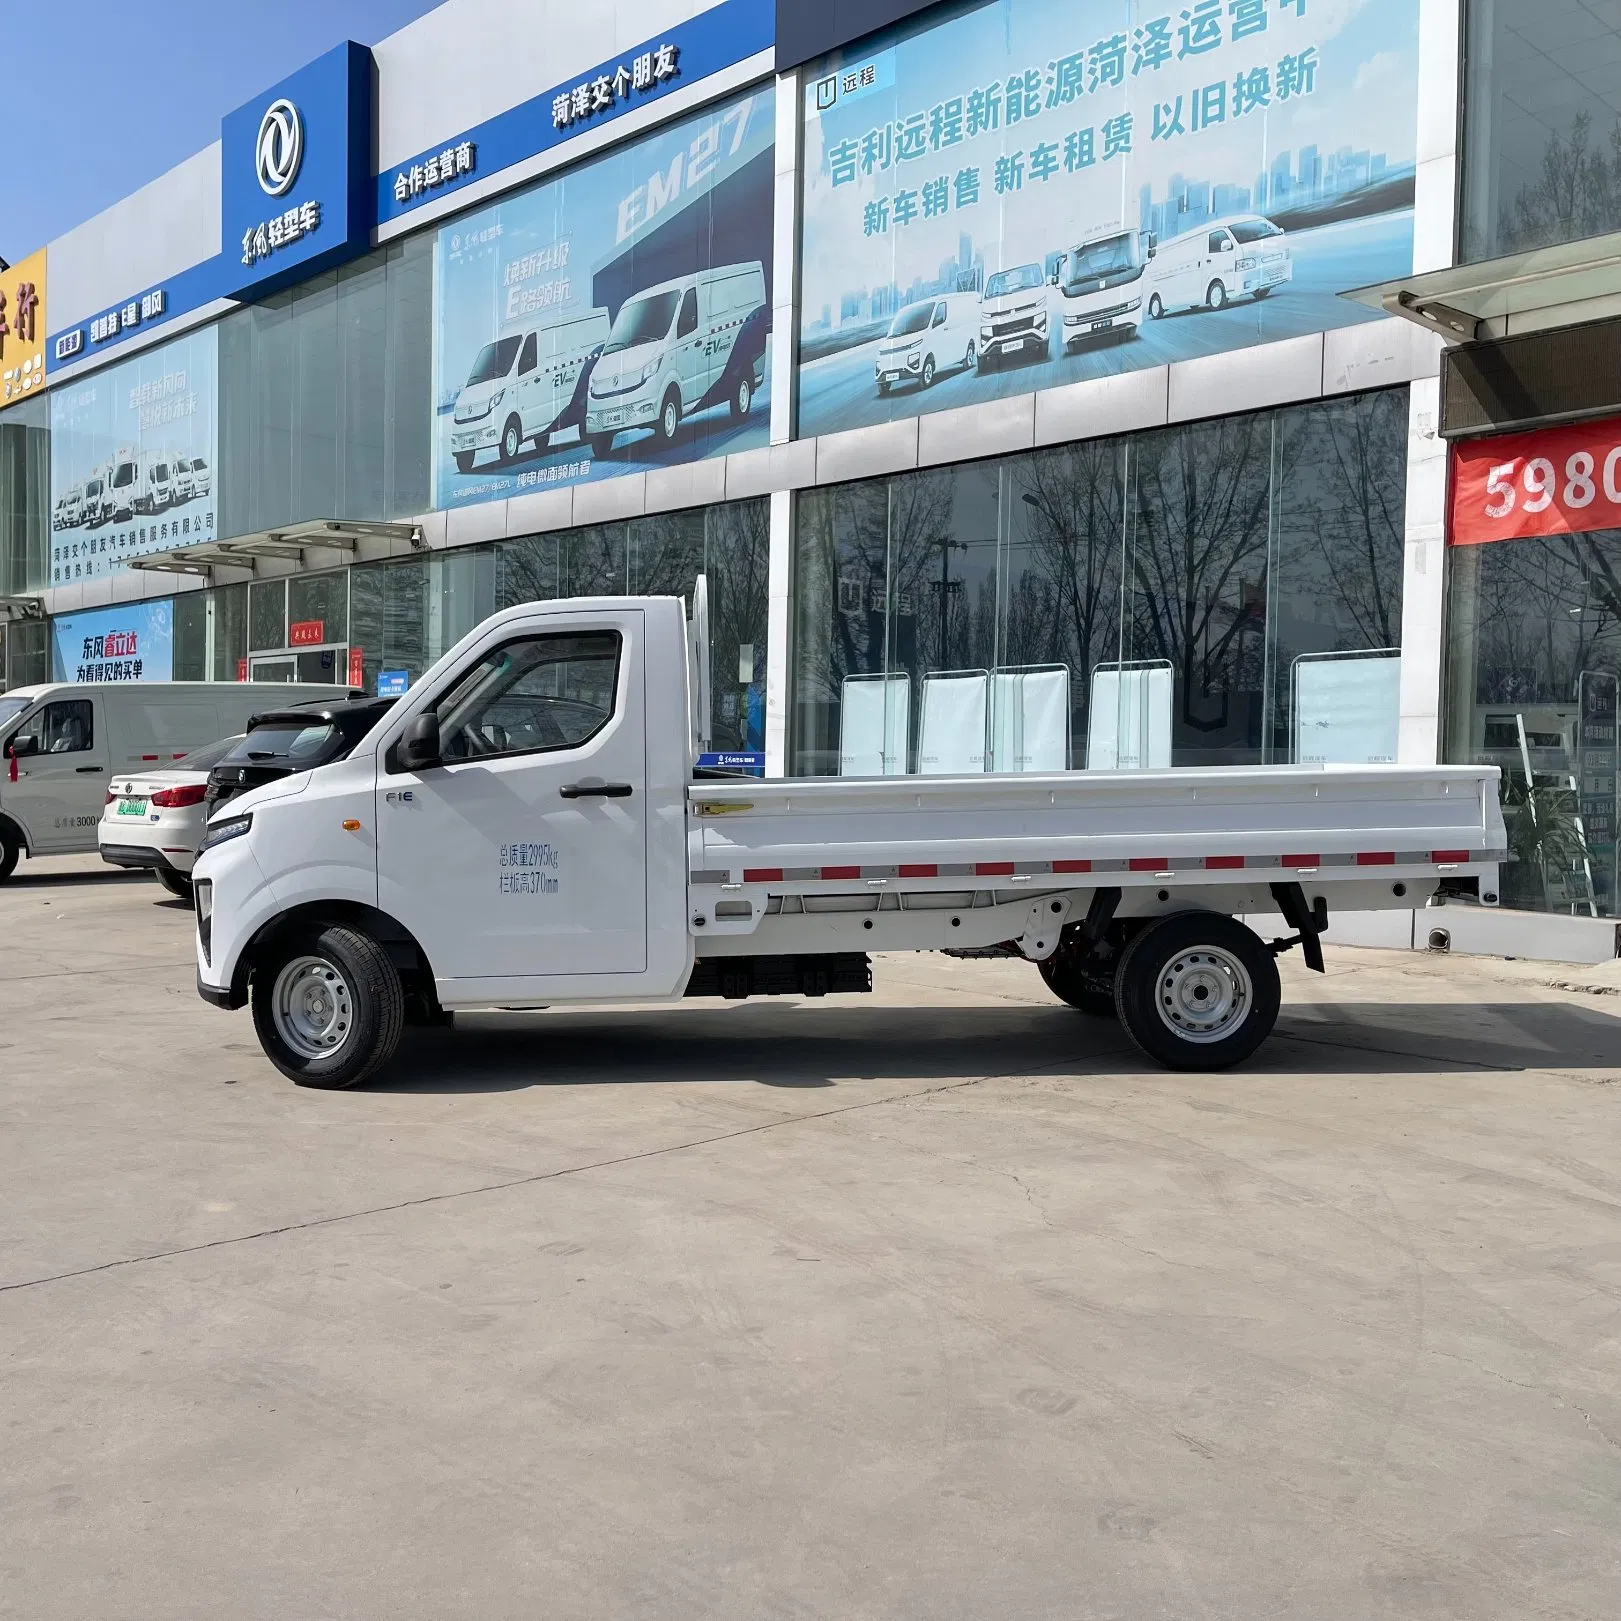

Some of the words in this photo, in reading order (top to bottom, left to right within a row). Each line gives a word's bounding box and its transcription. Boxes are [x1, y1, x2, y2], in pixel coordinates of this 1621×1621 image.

[828, 0, 1307, 188] 吉利远程新能源菏泽运营
[842, 64, 875, 96] 远程
[394, 141, 474, 201] 合作运营商
[552, 44, 676, 128] 菏泽交个朋友
[863, 166, 981, 238] 新车销售
[994, 112, 1134, 195] 新车租赁
[1150, 46, 1320, 142] 以旧换新
[615, 96, 756, 246] EM27
[241, 200, 317, 265] 东风轻型车
[516, 459, 591, 489] 纯电微面领航者
[82, 630, 138, 660] 东风睿立达
[76, 658, 143, 683] 为看得见的买单
[385, 791, 413, 802] F1E
[500, 843, 558, 869] 总质量2995kg
[500, 872, 559, 894] 栏板高370mm
